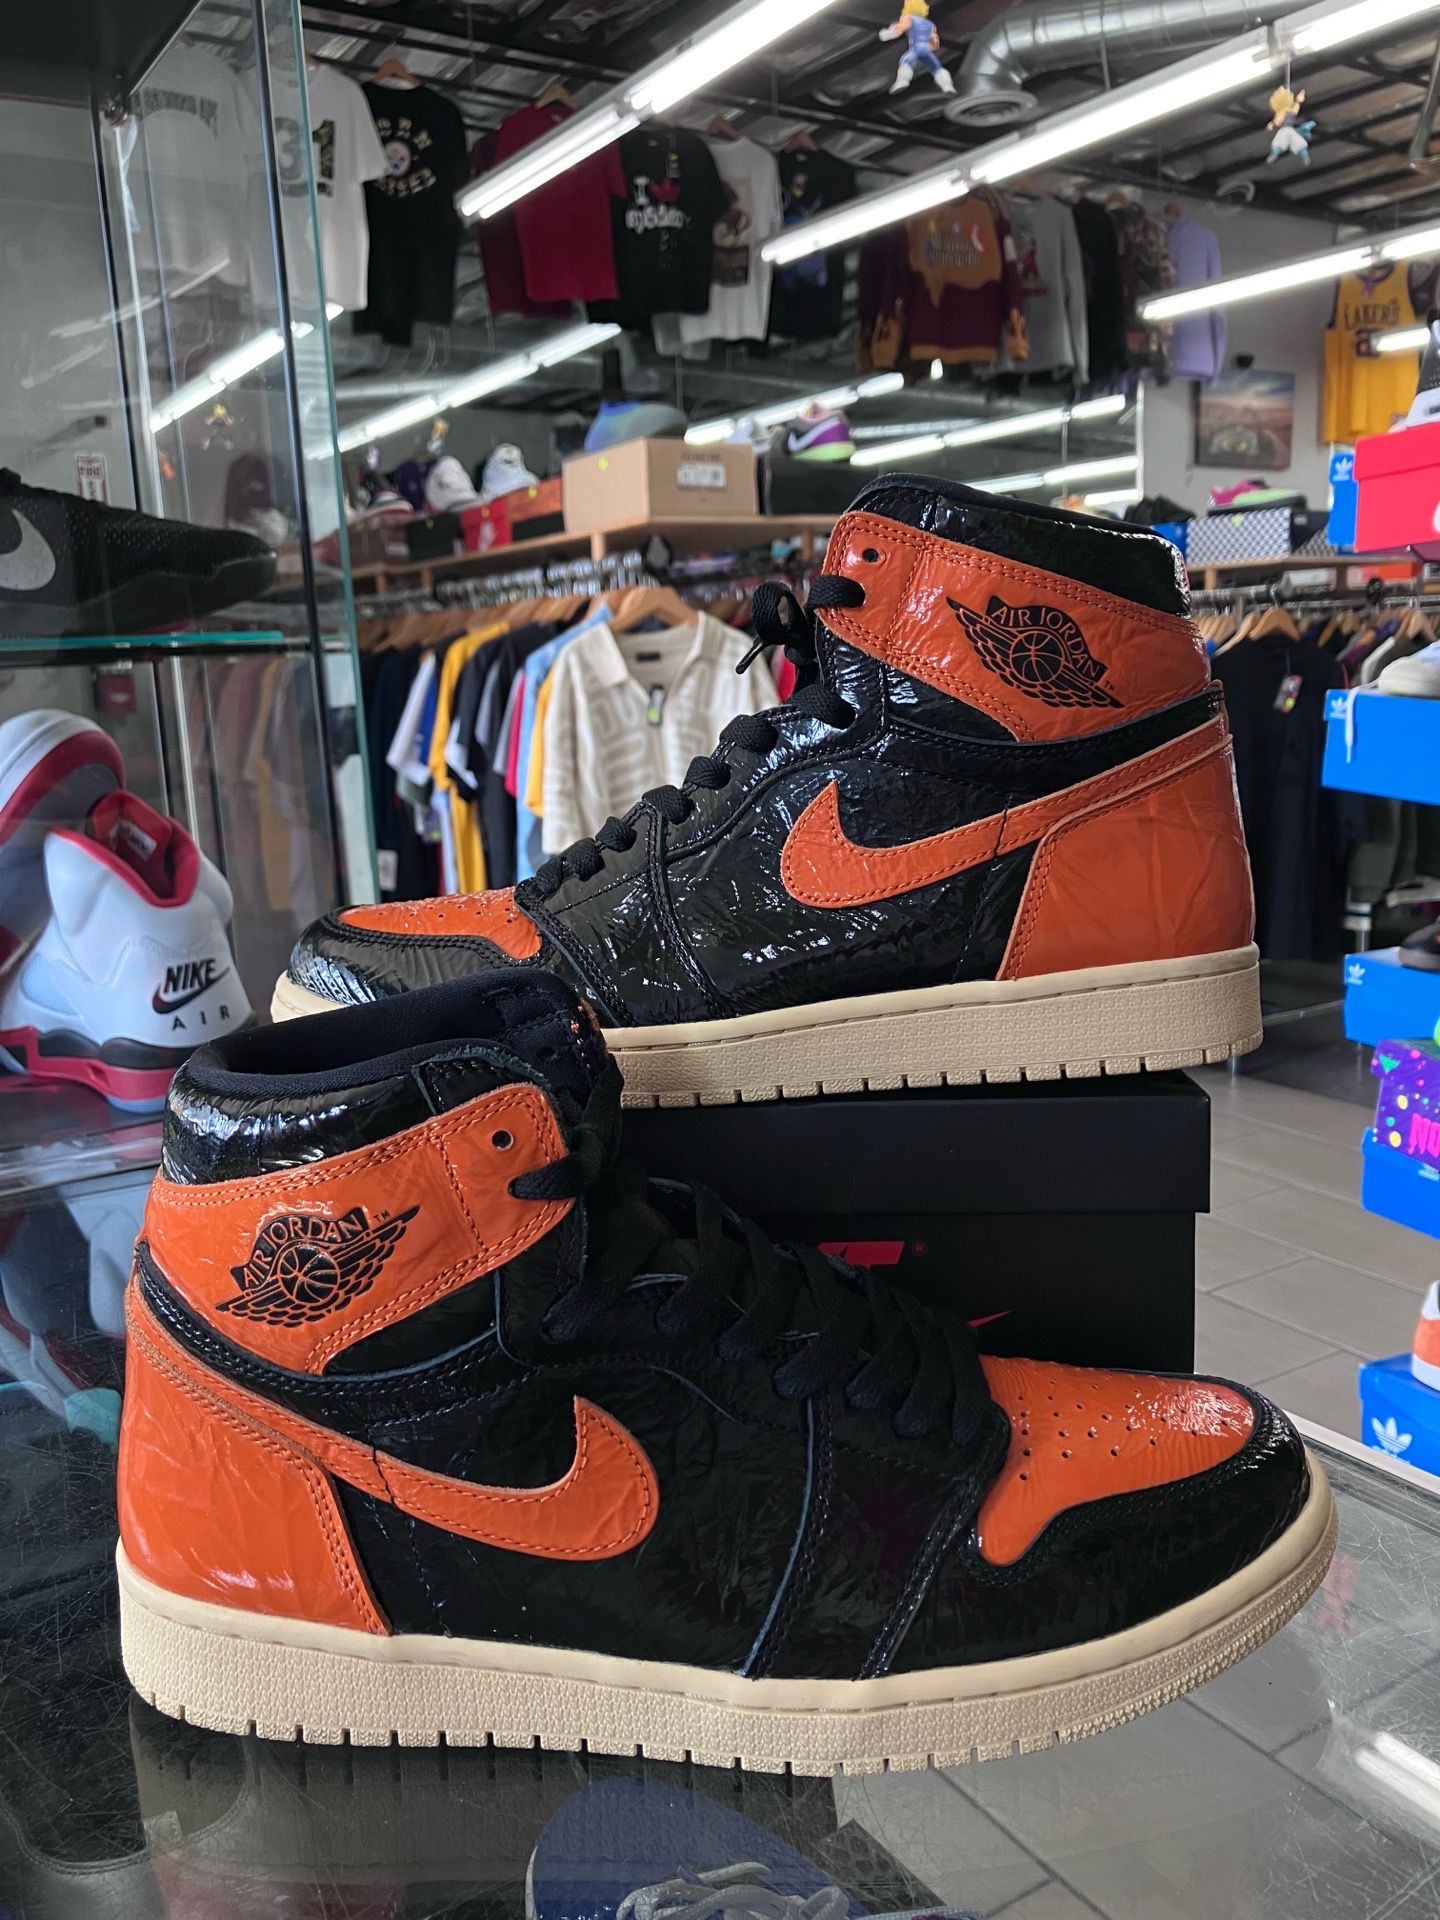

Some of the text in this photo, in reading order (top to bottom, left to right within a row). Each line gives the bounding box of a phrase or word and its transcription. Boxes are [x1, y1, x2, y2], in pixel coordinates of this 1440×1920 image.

[1343, 299, 1401, 330] LAKERS
[991, 605, 1100, 678] AIR JORDAN
[163, 957, 217, 994] NIKE
[171, 1003, 231, 1032] AIR
[243, 1213, 364, 1288] AIR JORDAN
